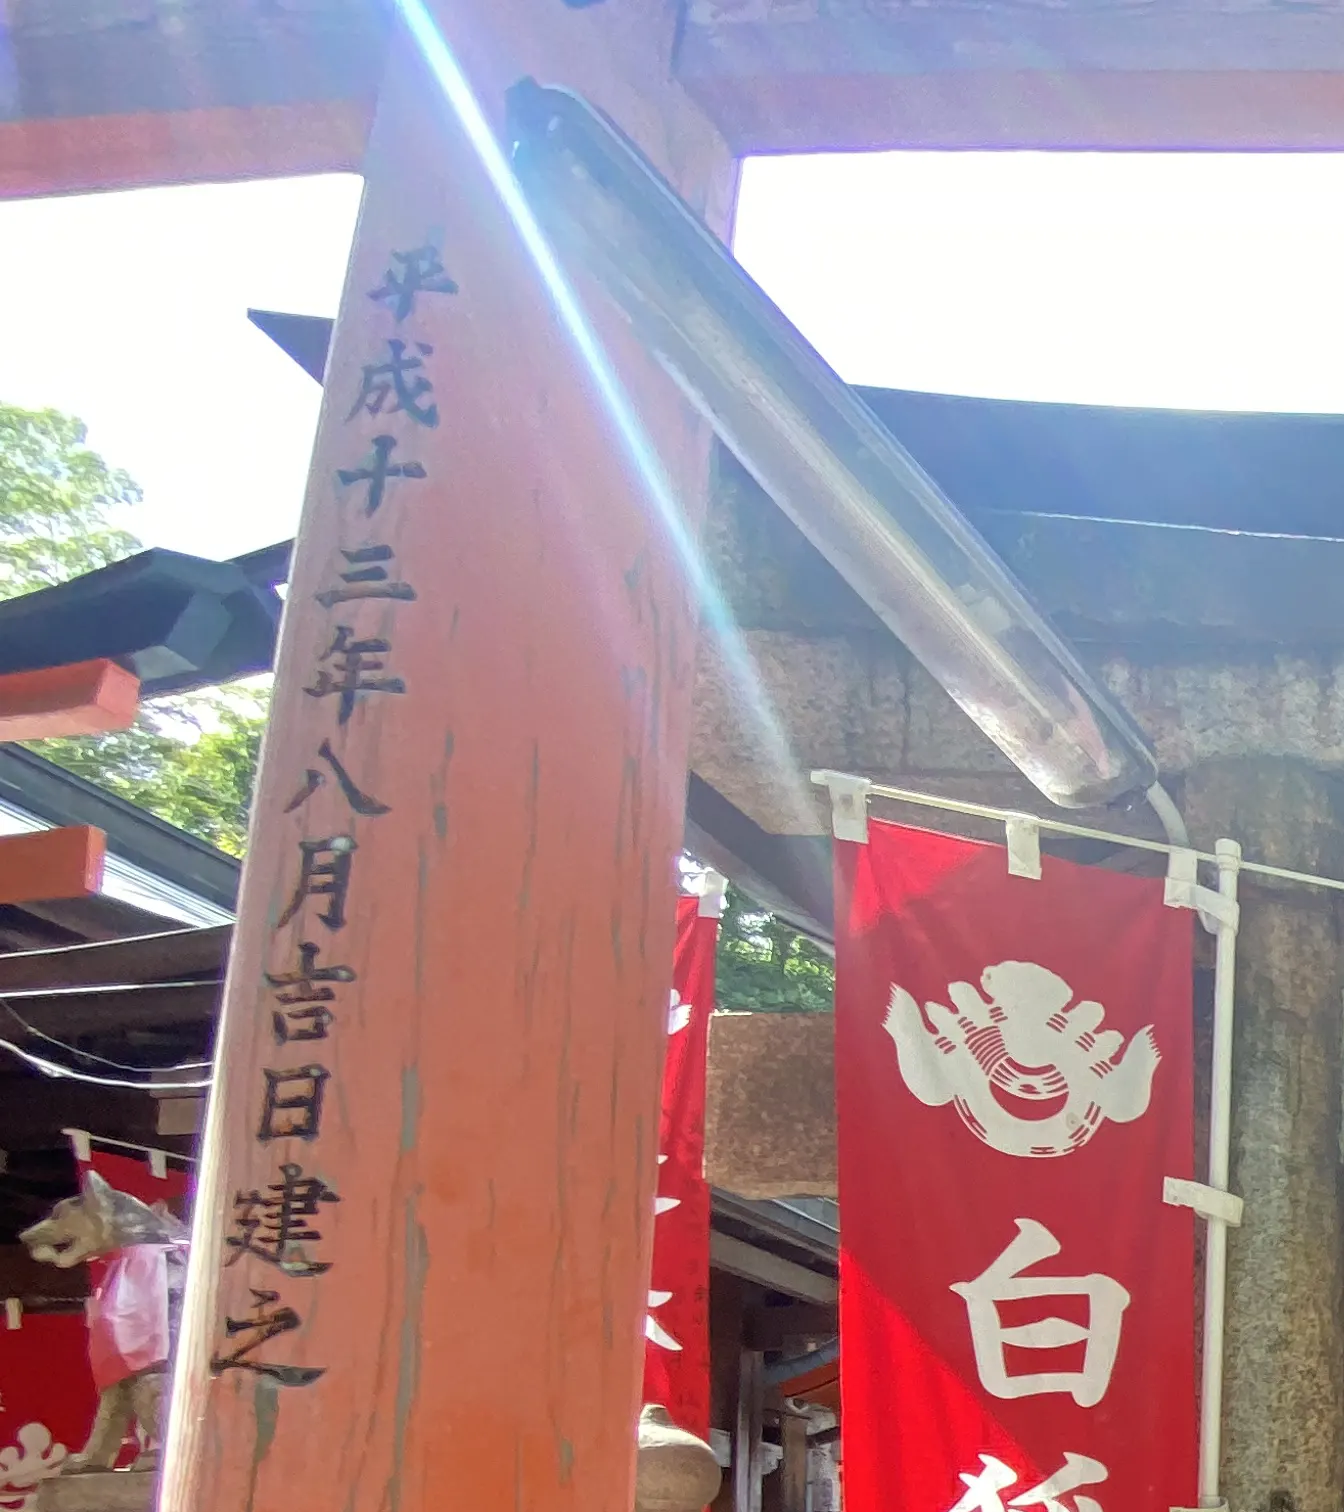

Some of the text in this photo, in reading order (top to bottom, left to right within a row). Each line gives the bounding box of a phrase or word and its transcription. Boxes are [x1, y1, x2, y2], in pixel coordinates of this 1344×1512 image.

[210, 245, 458, 1387] 平成十三年八月吉日建之
